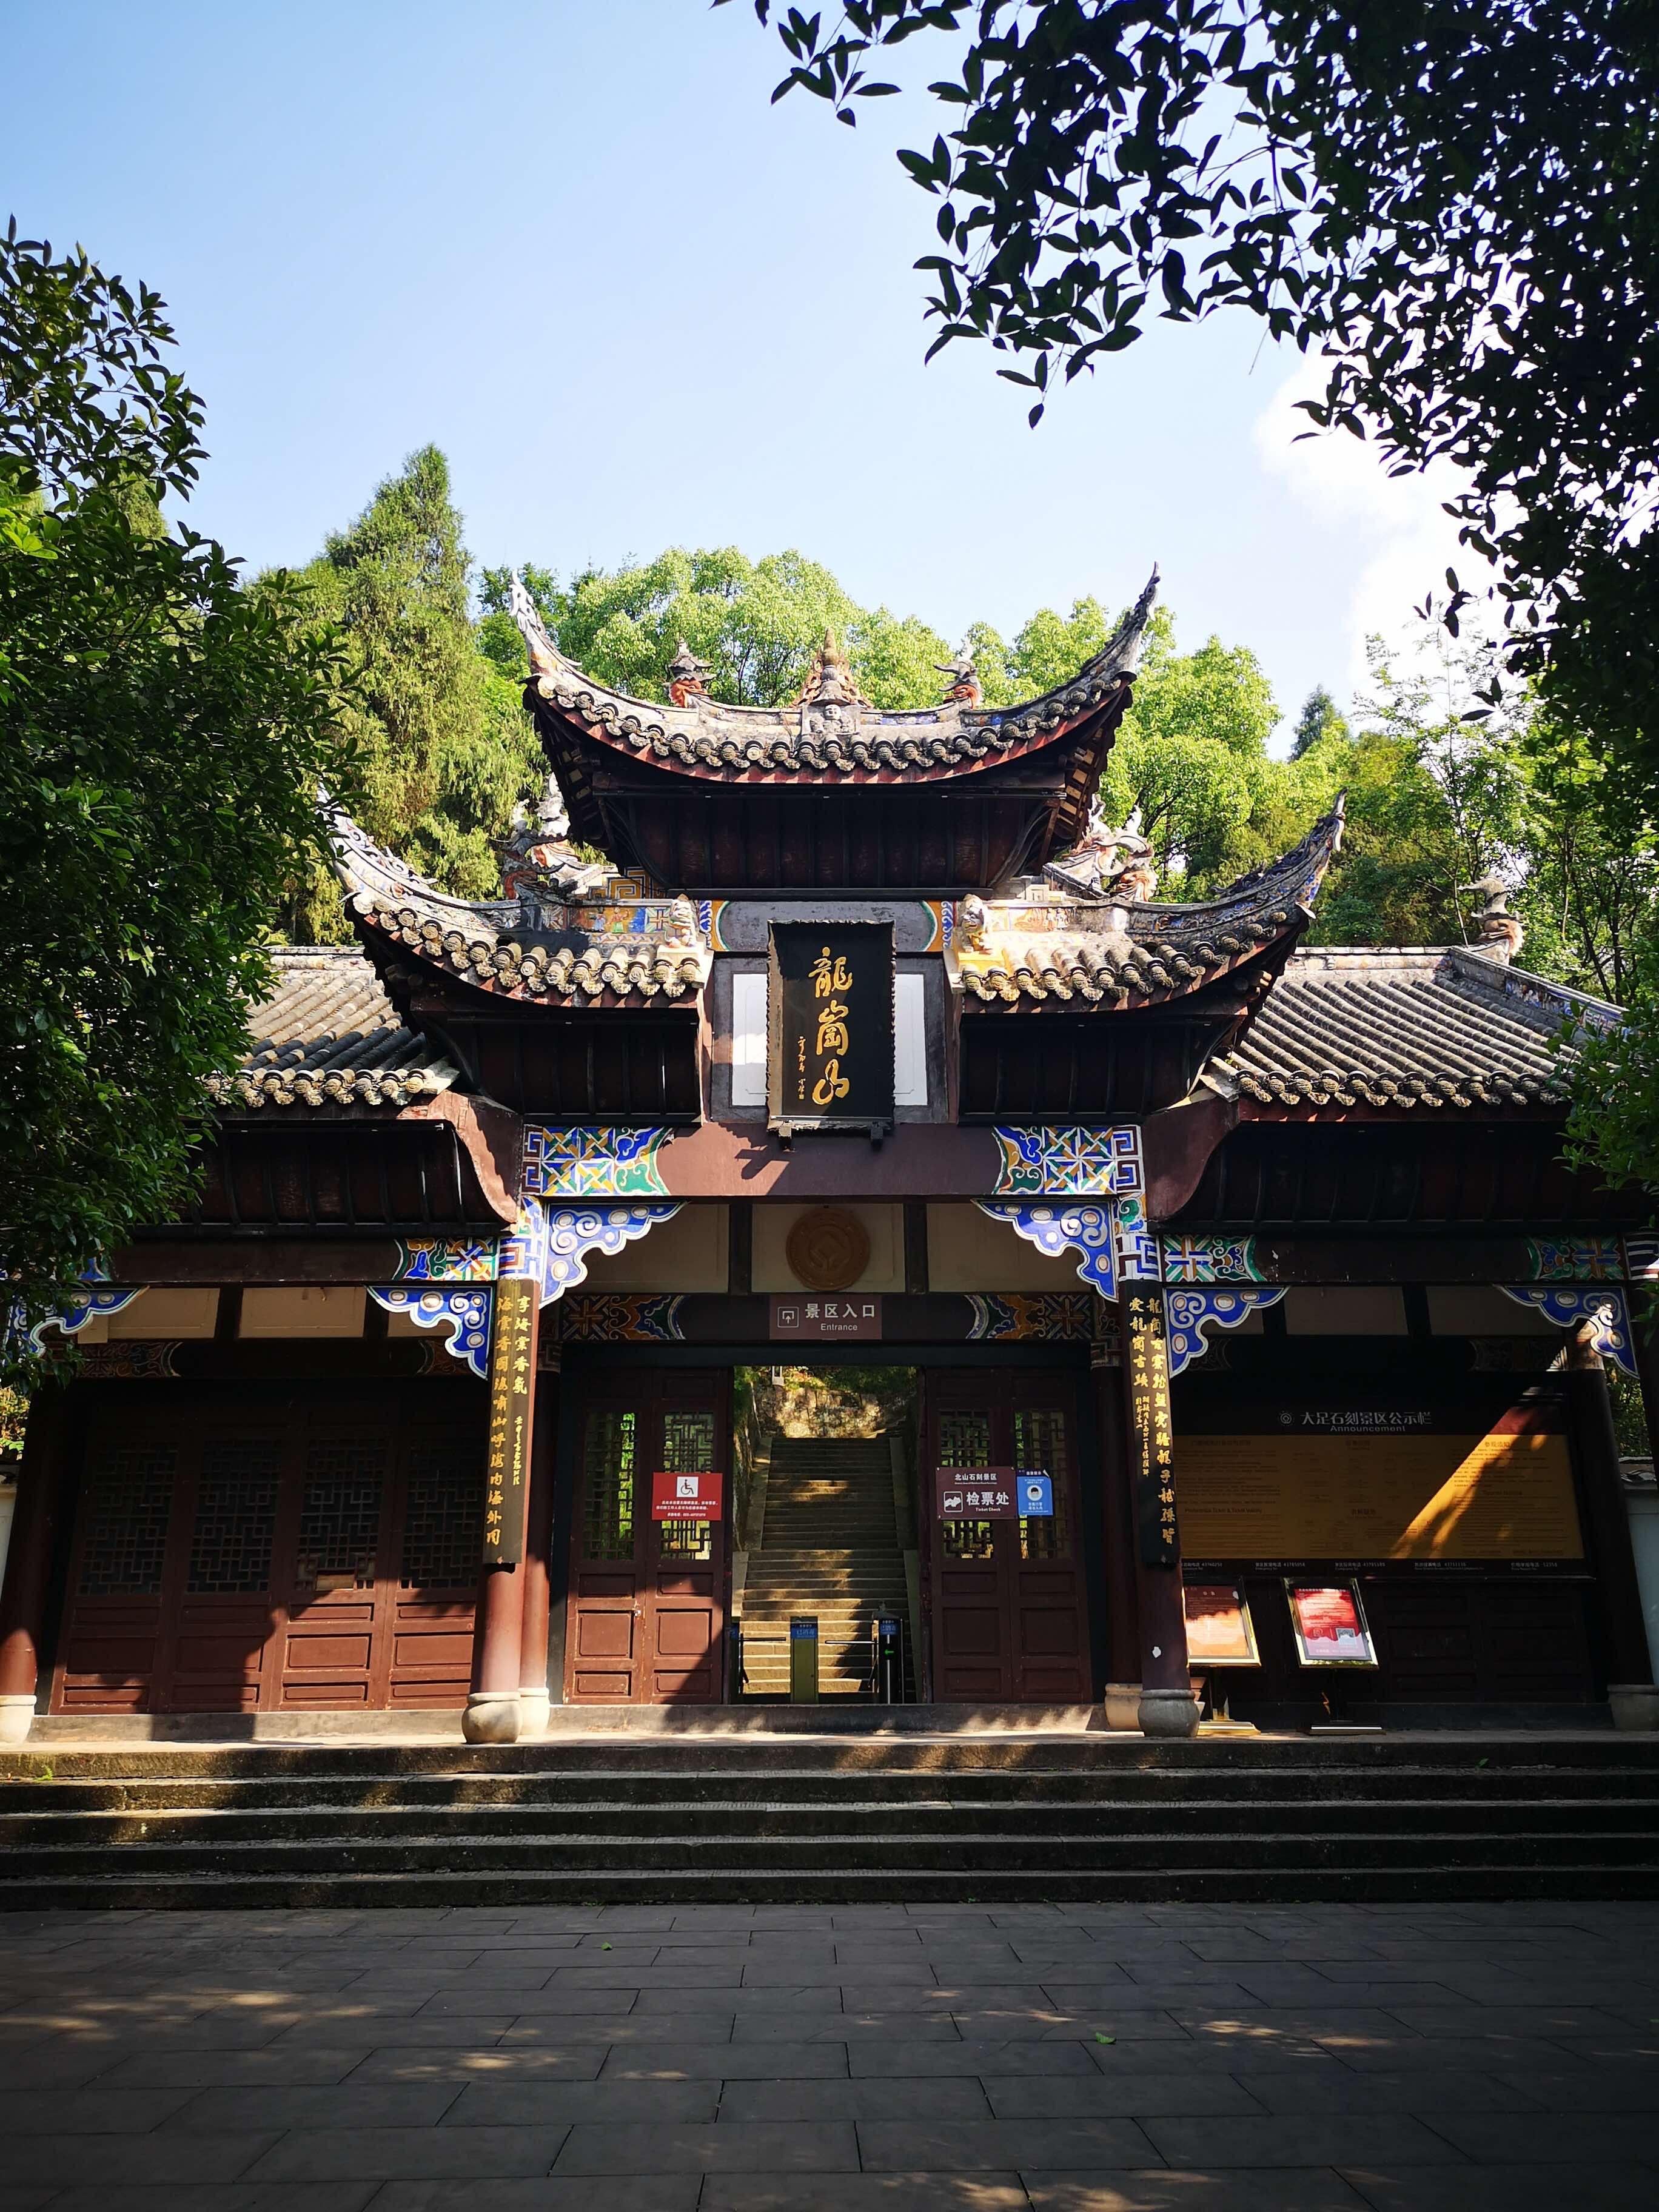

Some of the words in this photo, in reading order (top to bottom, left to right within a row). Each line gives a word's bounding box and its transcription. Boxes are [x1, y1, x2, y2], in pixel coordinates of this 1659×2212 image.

[805, 1303, 874, 1318] 景区入口
[1302, 1412, 1432, 1425] 大足石刻景区公示栏
[966, 1492, 1010, 1506] 检票处
